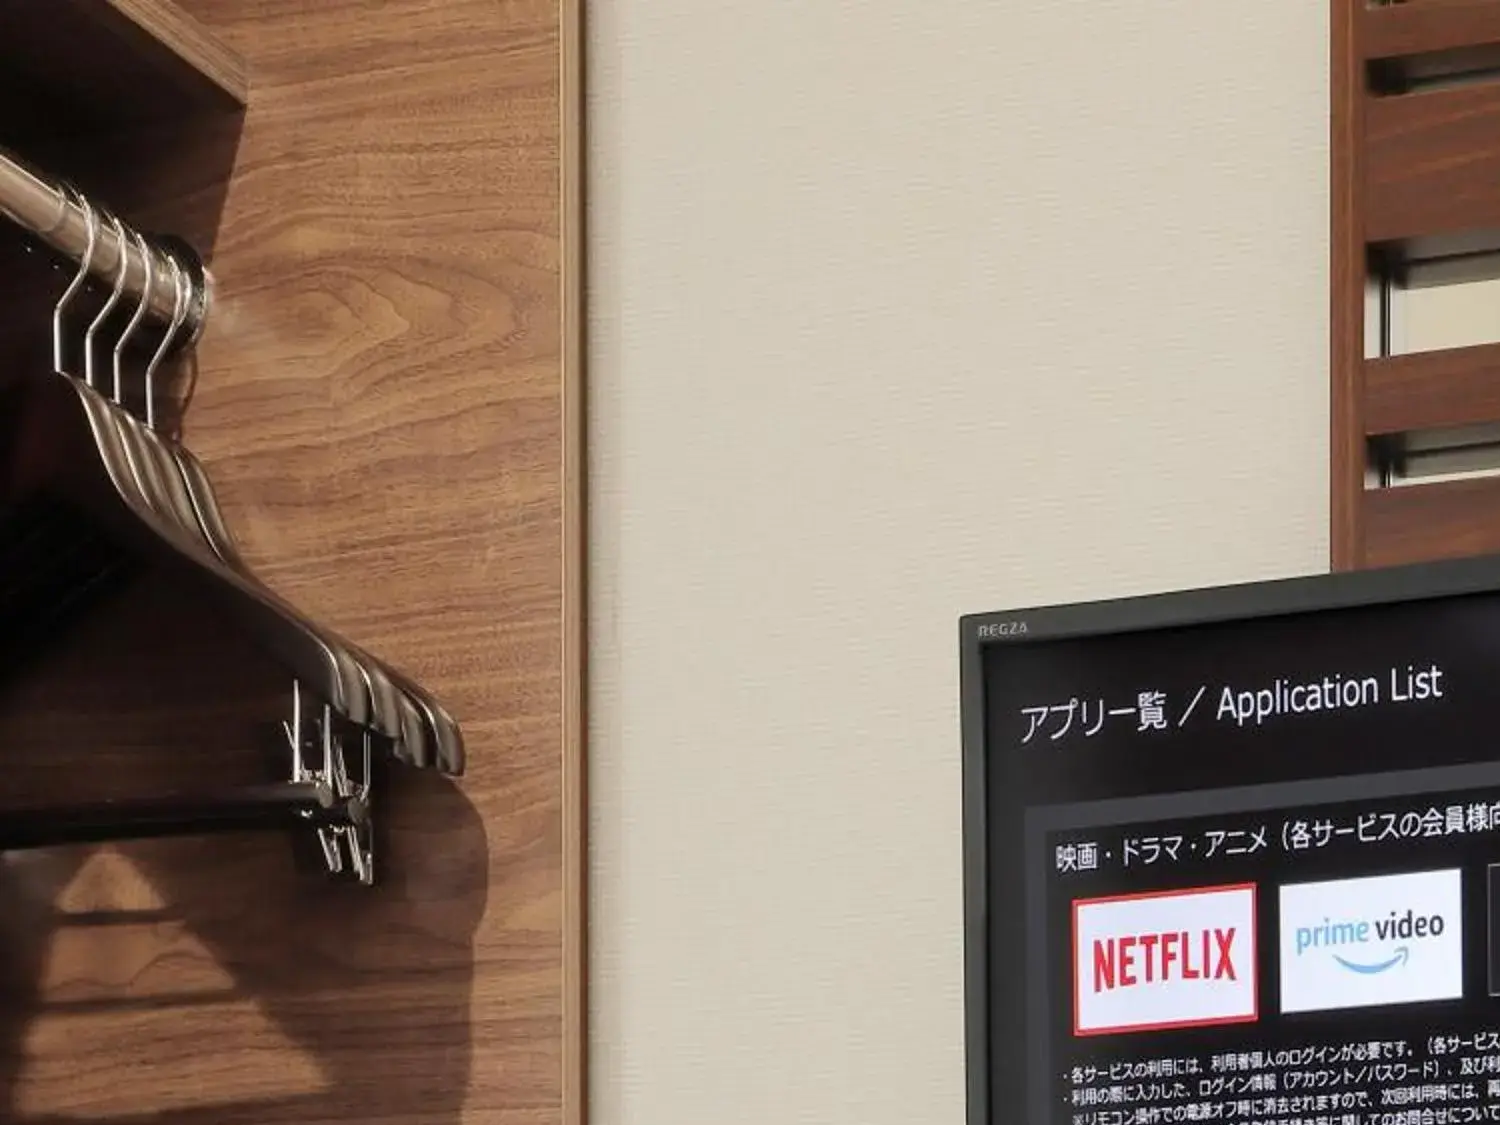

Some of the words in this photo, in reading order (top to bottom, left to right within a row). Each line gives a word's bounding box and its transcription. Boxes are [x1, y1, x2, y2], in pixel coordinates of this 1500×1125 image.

[977, 621, 1028, 637] REGZA
[1020, 692, 1168, 743] アプリ一覧
[1217, 679, 1380, 724] Application
[1391, 665, 1444, 703] List
[1296, 919, 1370, 951] prime
[1375, 911, 1445, 944] video
[1093, 926, 1237, 993] NETFLIX
